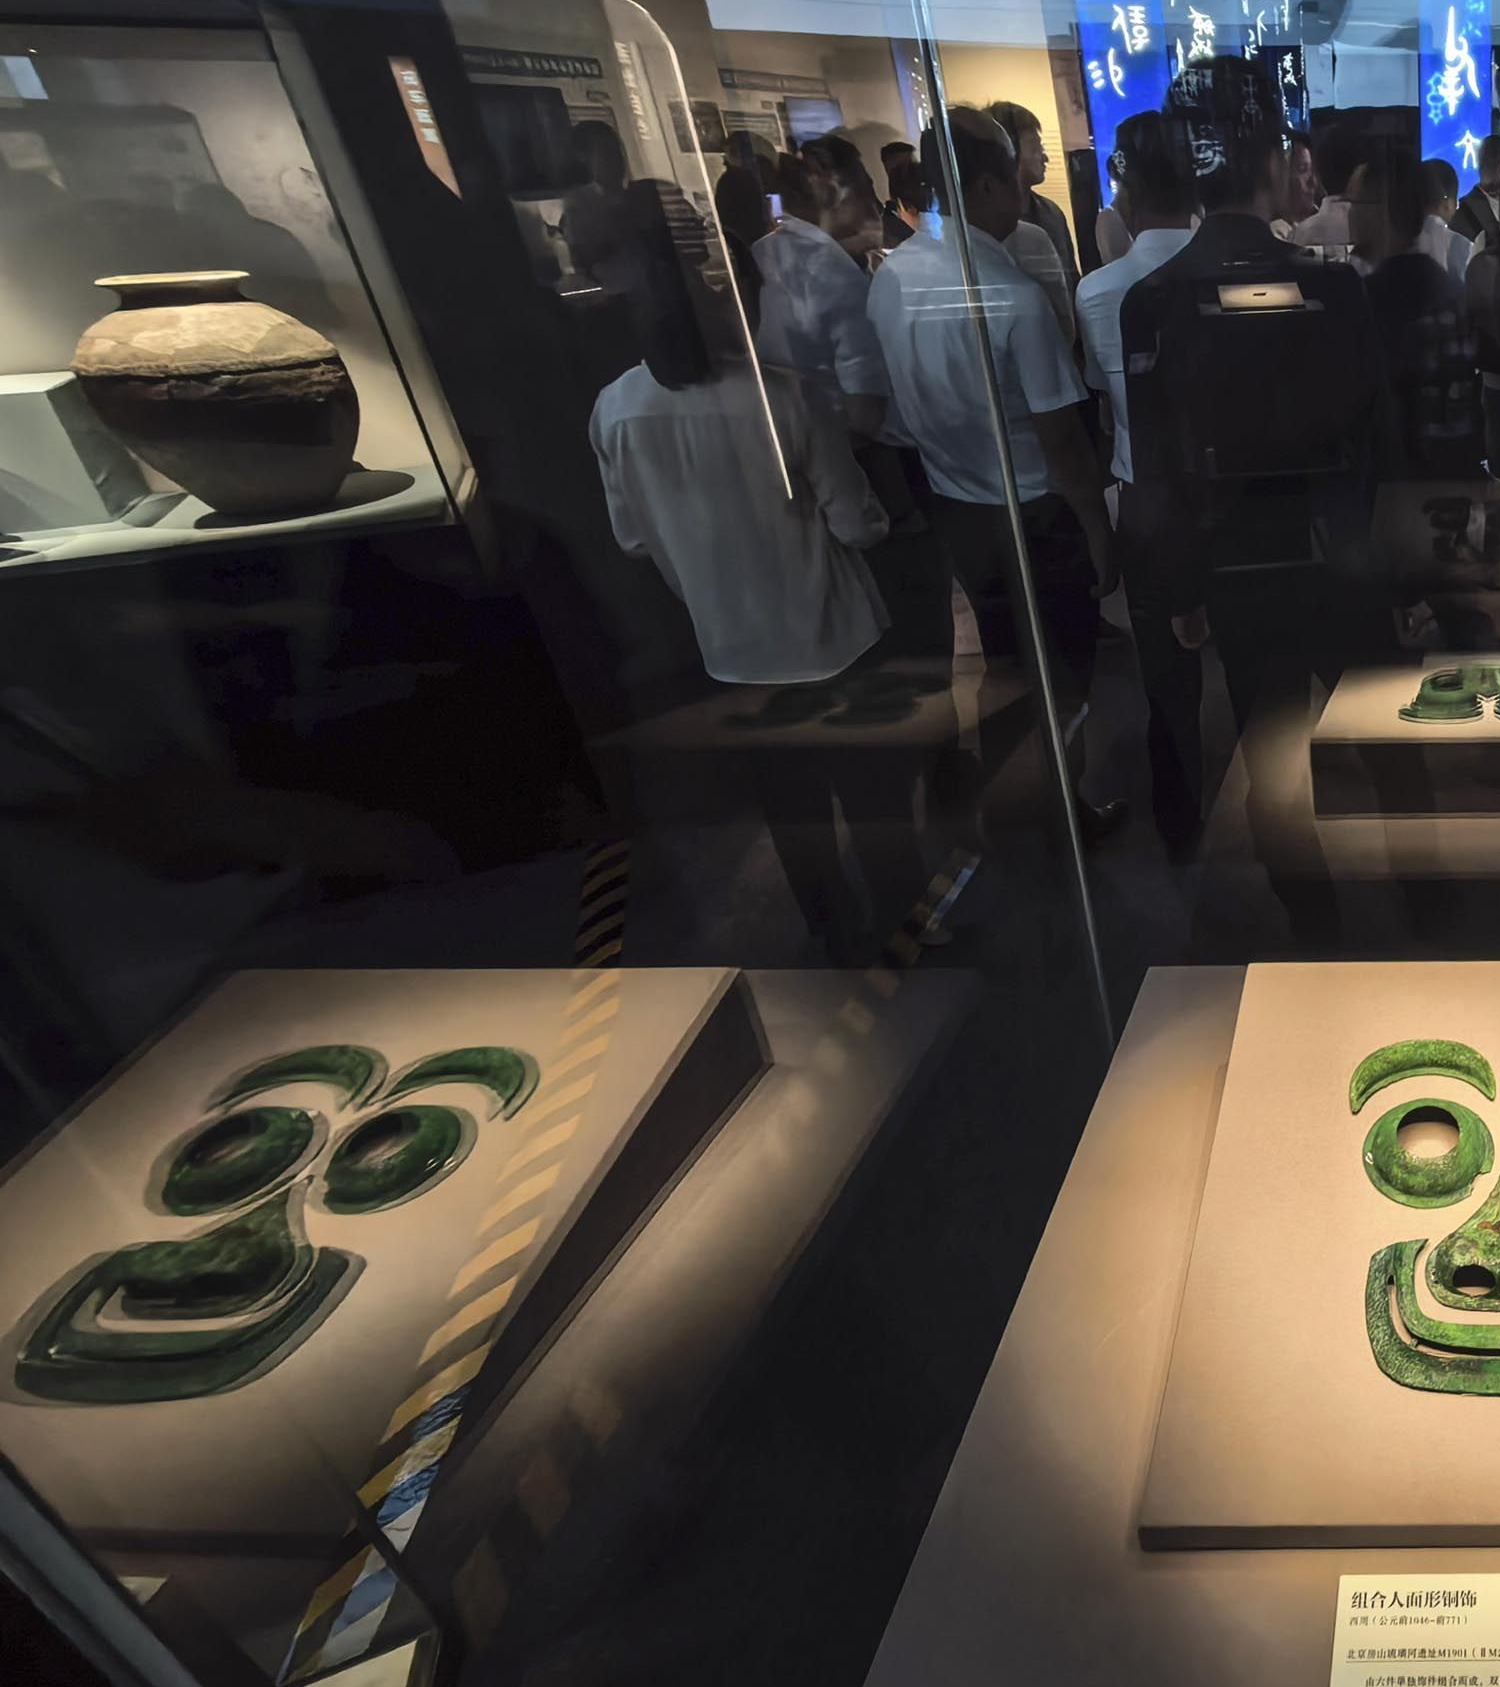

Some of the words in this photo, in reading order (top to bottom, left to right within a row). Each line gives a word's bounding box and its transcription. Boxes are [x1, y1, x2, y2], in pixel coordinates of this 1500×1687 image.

[1351, 1590, 1477, 1609] 组合人面形铜饰
